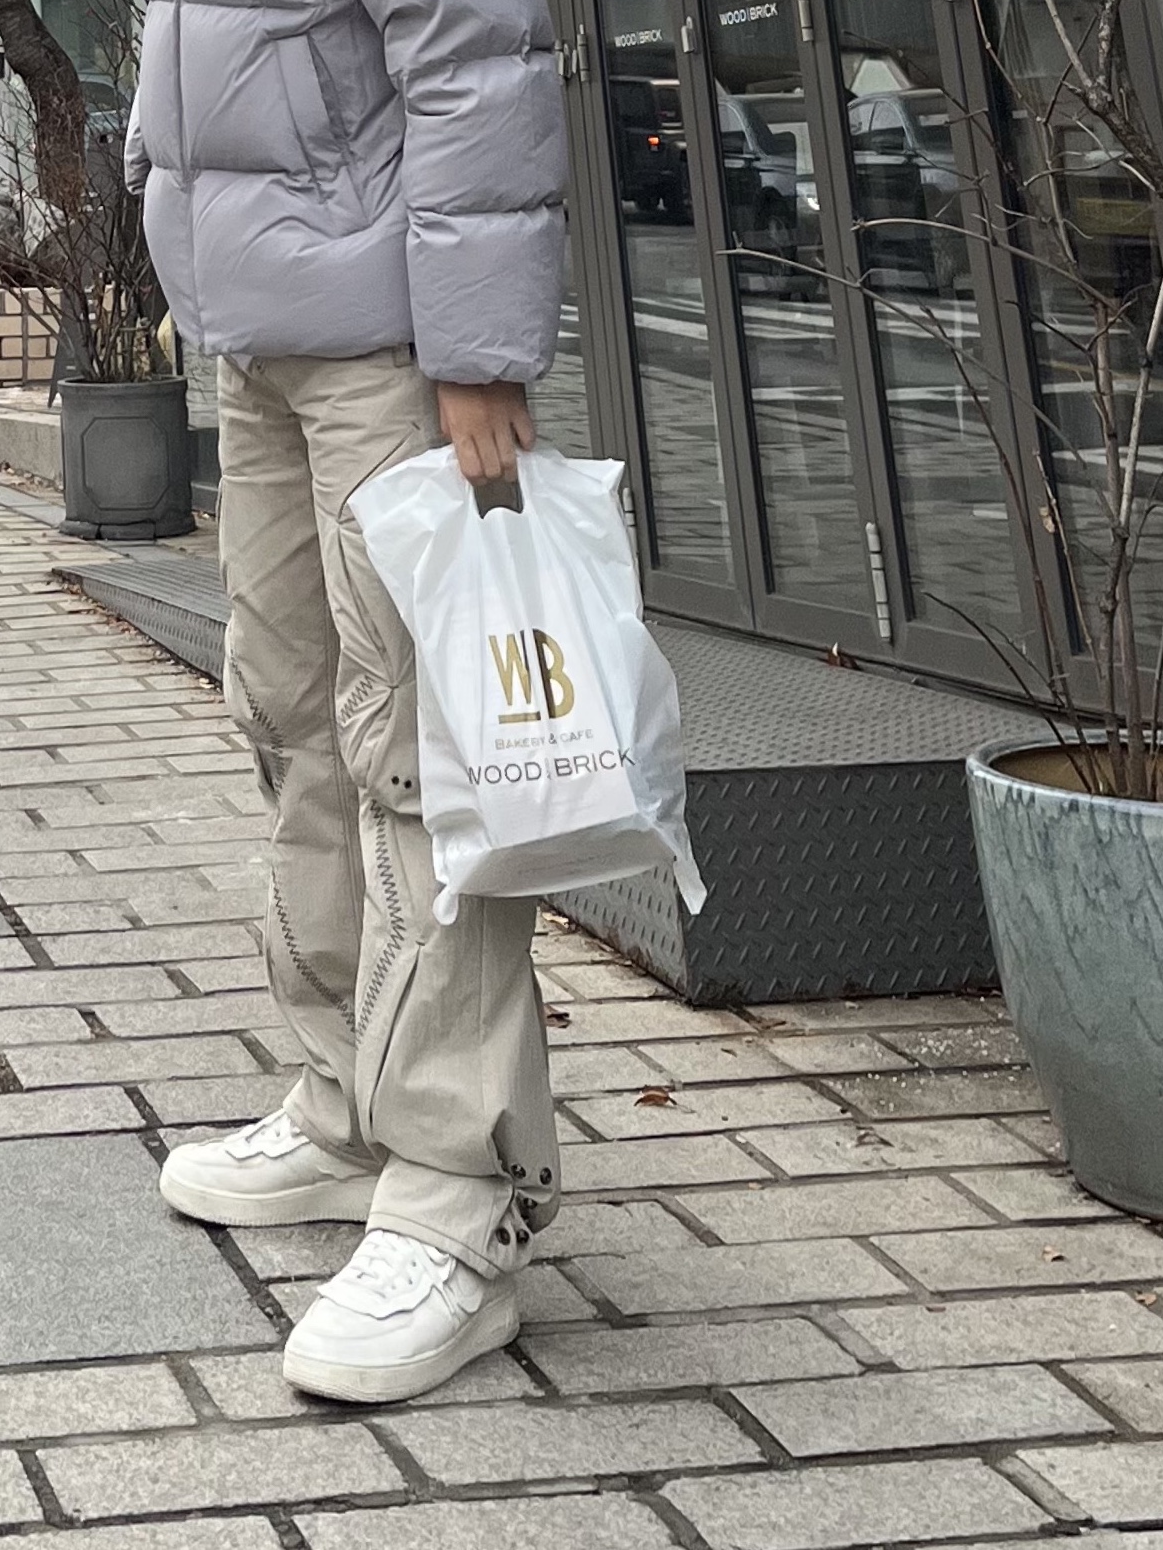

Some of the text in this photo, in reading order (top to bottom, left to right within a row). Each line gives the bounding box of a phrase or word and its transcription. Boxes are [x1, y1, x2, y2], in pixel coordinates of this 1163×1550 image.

[719, 2, 778, 25] WOOD BRICK
[494, 728, 594, 751] BAKERY & CAFE
[467, 747, 636, 785] WOOD BRICK
